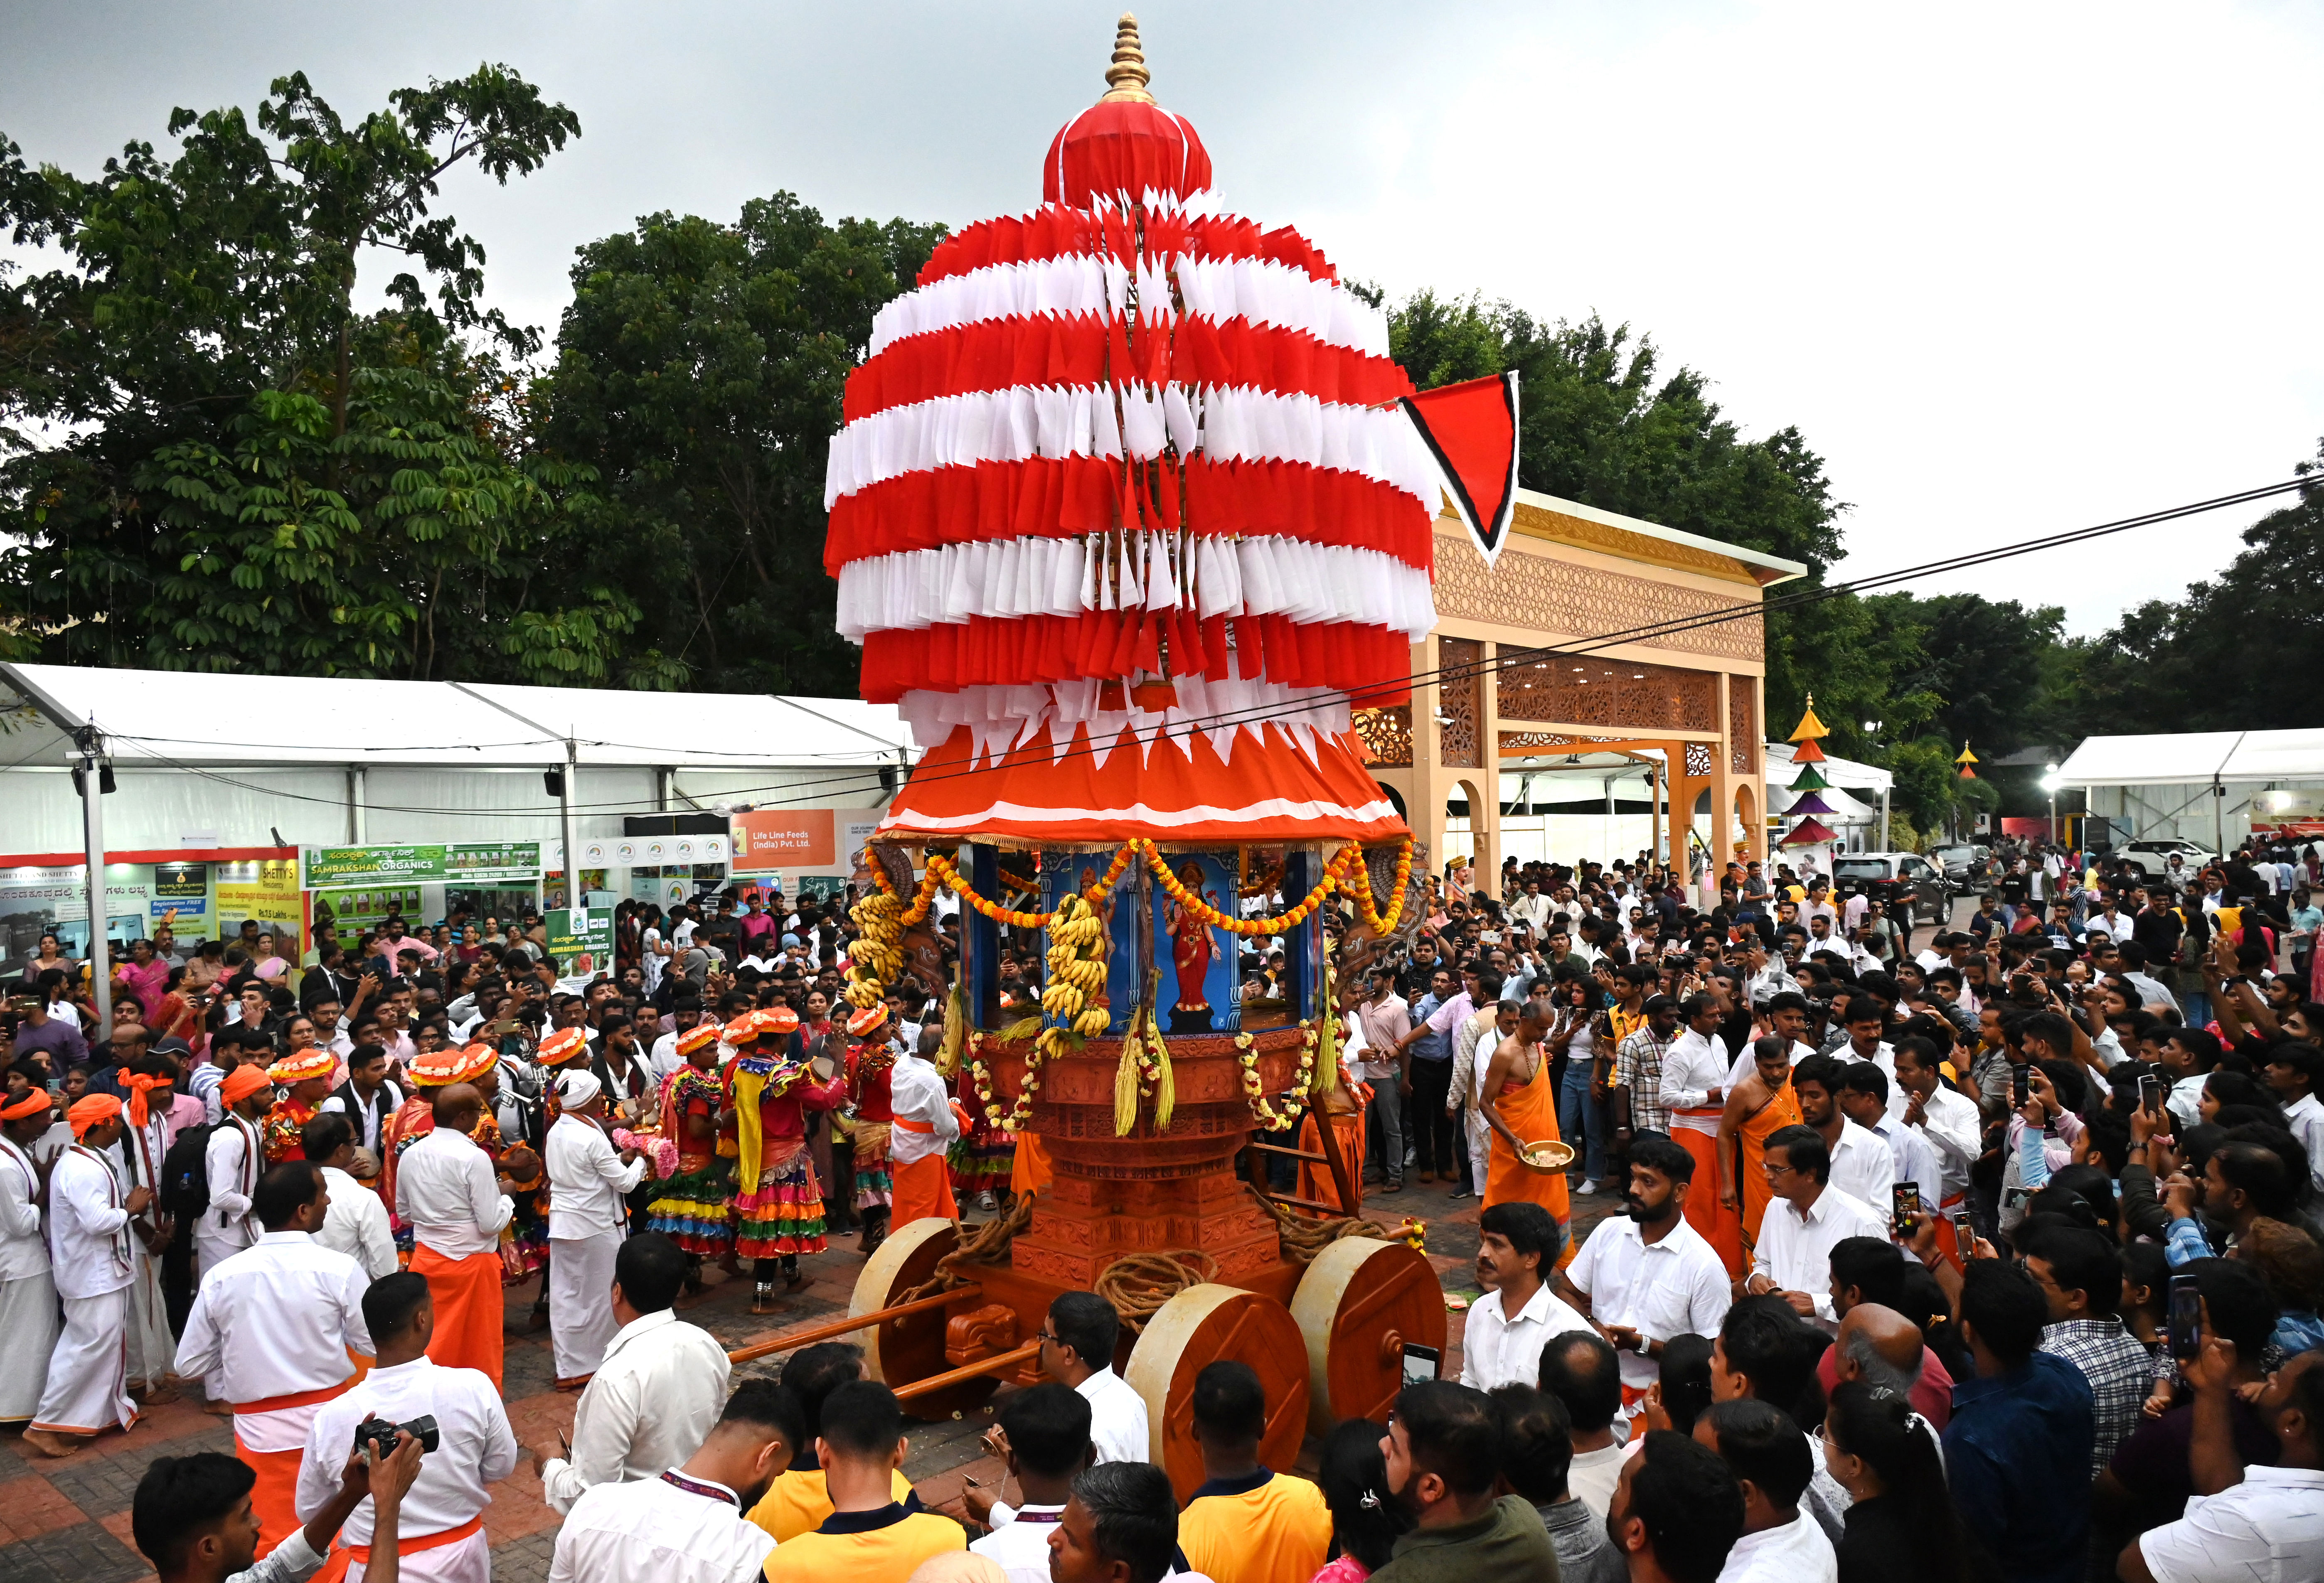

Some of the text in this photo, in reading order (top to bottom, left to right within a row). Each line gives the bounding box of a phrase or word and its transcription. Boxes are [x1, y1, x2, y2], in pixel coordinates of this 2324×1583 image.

[753, 841, 778, 849] (India)
[311, 861, 433, 874] SAMRAKSHAN ORGANICS
[263, 868, 293, 879] SHETTY'S
[263, 880, 284, 890] Residency
[128, 885, 148, 898] ಲಭ್ಯ
[549, 945, 584, 954] SAMRAKSHAN
